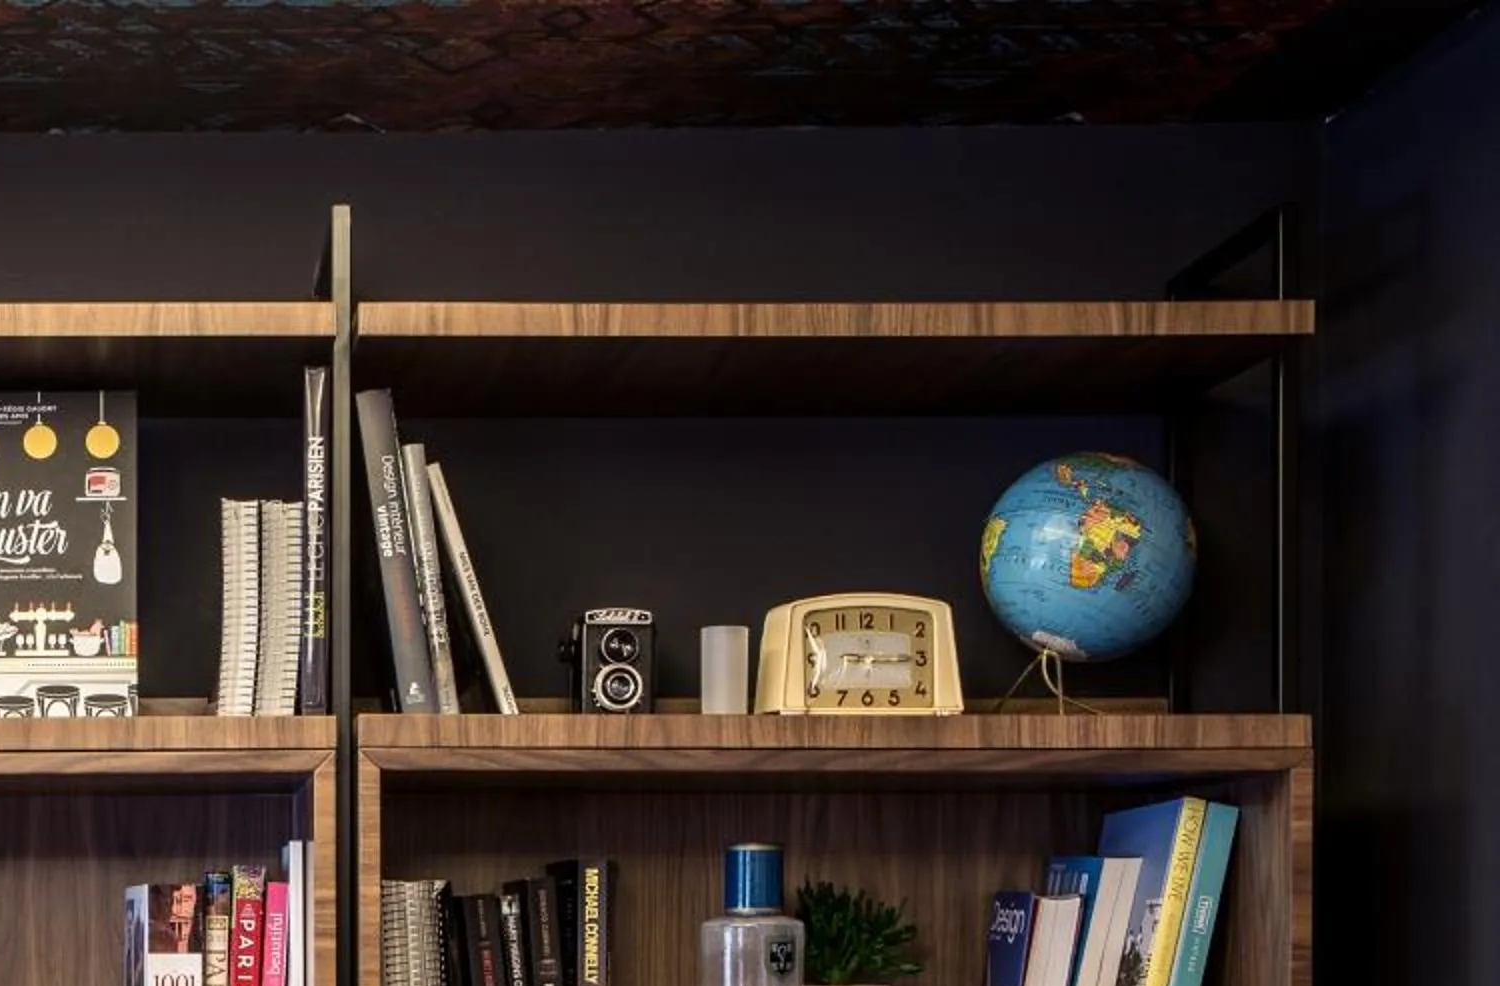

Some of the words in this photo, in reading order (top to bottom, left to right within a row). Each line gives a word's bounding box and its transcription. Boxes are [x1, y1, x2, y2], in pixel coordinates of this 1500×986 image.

[307, 436, 324, 512] PARISIEN
[381, 455, 397, 499] Design
[15, 489, 52, 517] va
[376, 505, 393, 557] vintage
[859, 611, 875, 630] 12
[915, 621, 925, 638] 2
[915, 650, 928, 667] 3
[836, 689, 849, 707] 7
[861, 689, 875, 707] 6
[887, 689, 900, 707] 5
[915, 681, 927, 698] 4
[584, 868, 599, 921] MICHAEL
[267, 912, 284, 976] beautiful
[584, 923, 599, 985] CONNELLY
